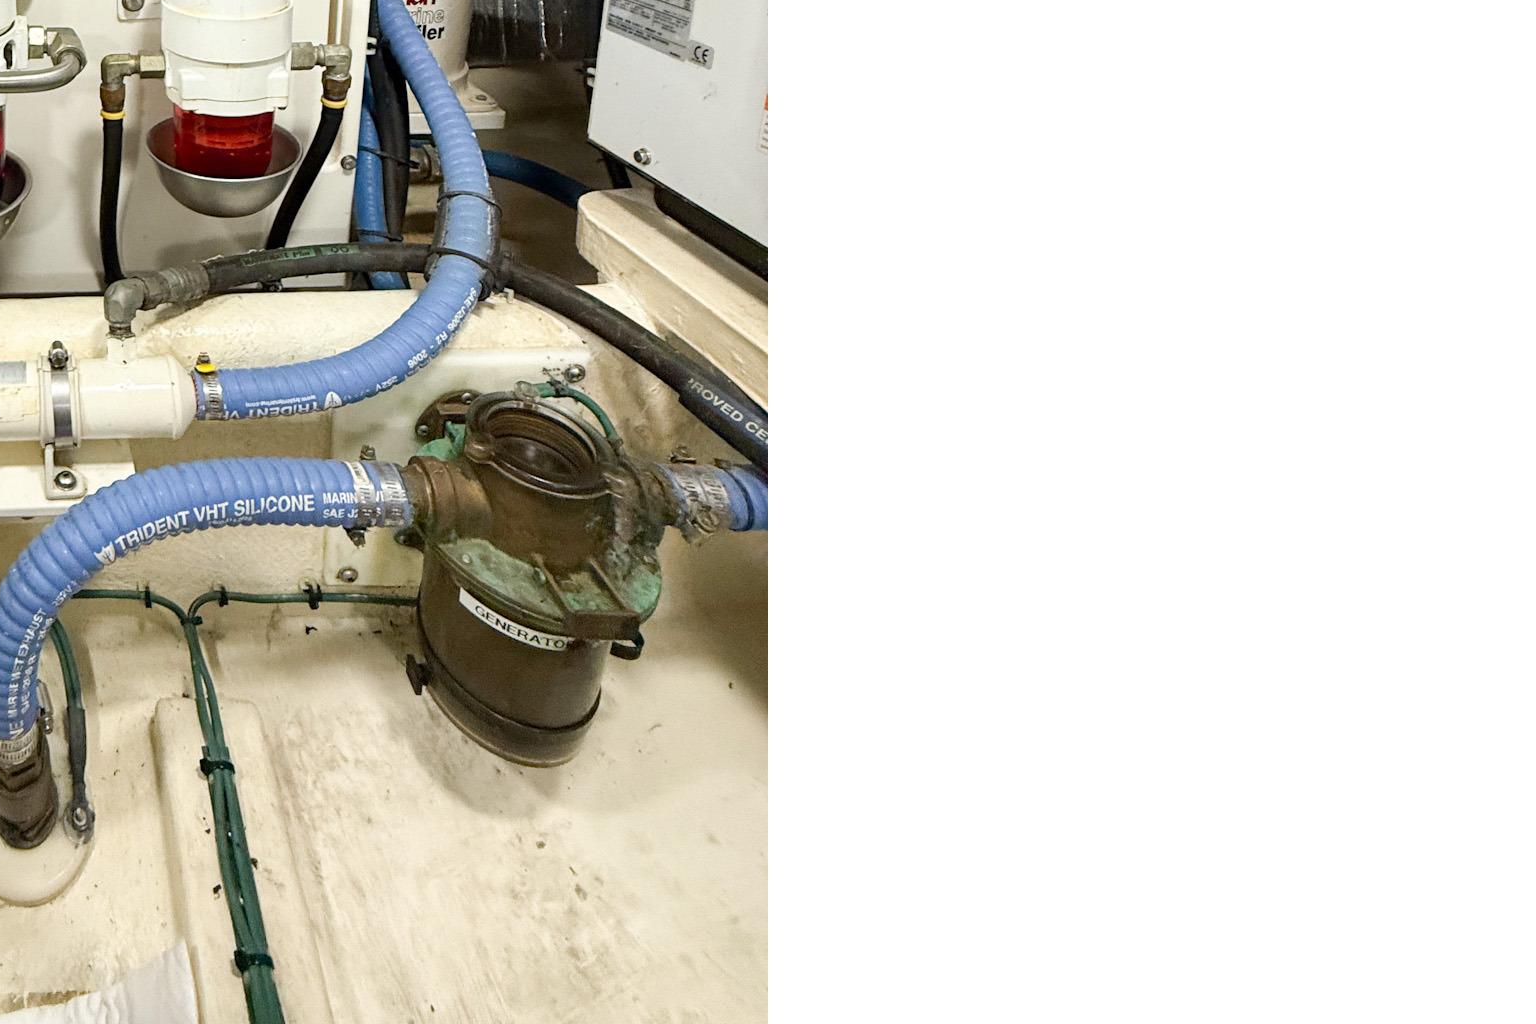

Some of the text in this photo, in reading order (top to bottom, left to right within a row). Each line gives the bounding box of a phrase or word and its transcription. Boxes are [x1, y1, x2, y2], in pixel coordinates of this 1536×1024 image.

[410, 7, 445, 25] rine
[407, 350, 428, 369] 2006
[745, 421, 769, 445] CE
[323, 491, 358, 504] MARIN
[115, 510, 190, 553] TRIDENT
[193, 501, 229, 523] VHT
[233, 493, 315, 518] SILICONE
[323, 508, 344, 519] SAE
[18, 607, 47, 658] EXHAUST
[475, 605, 565, 650] GENERATO
